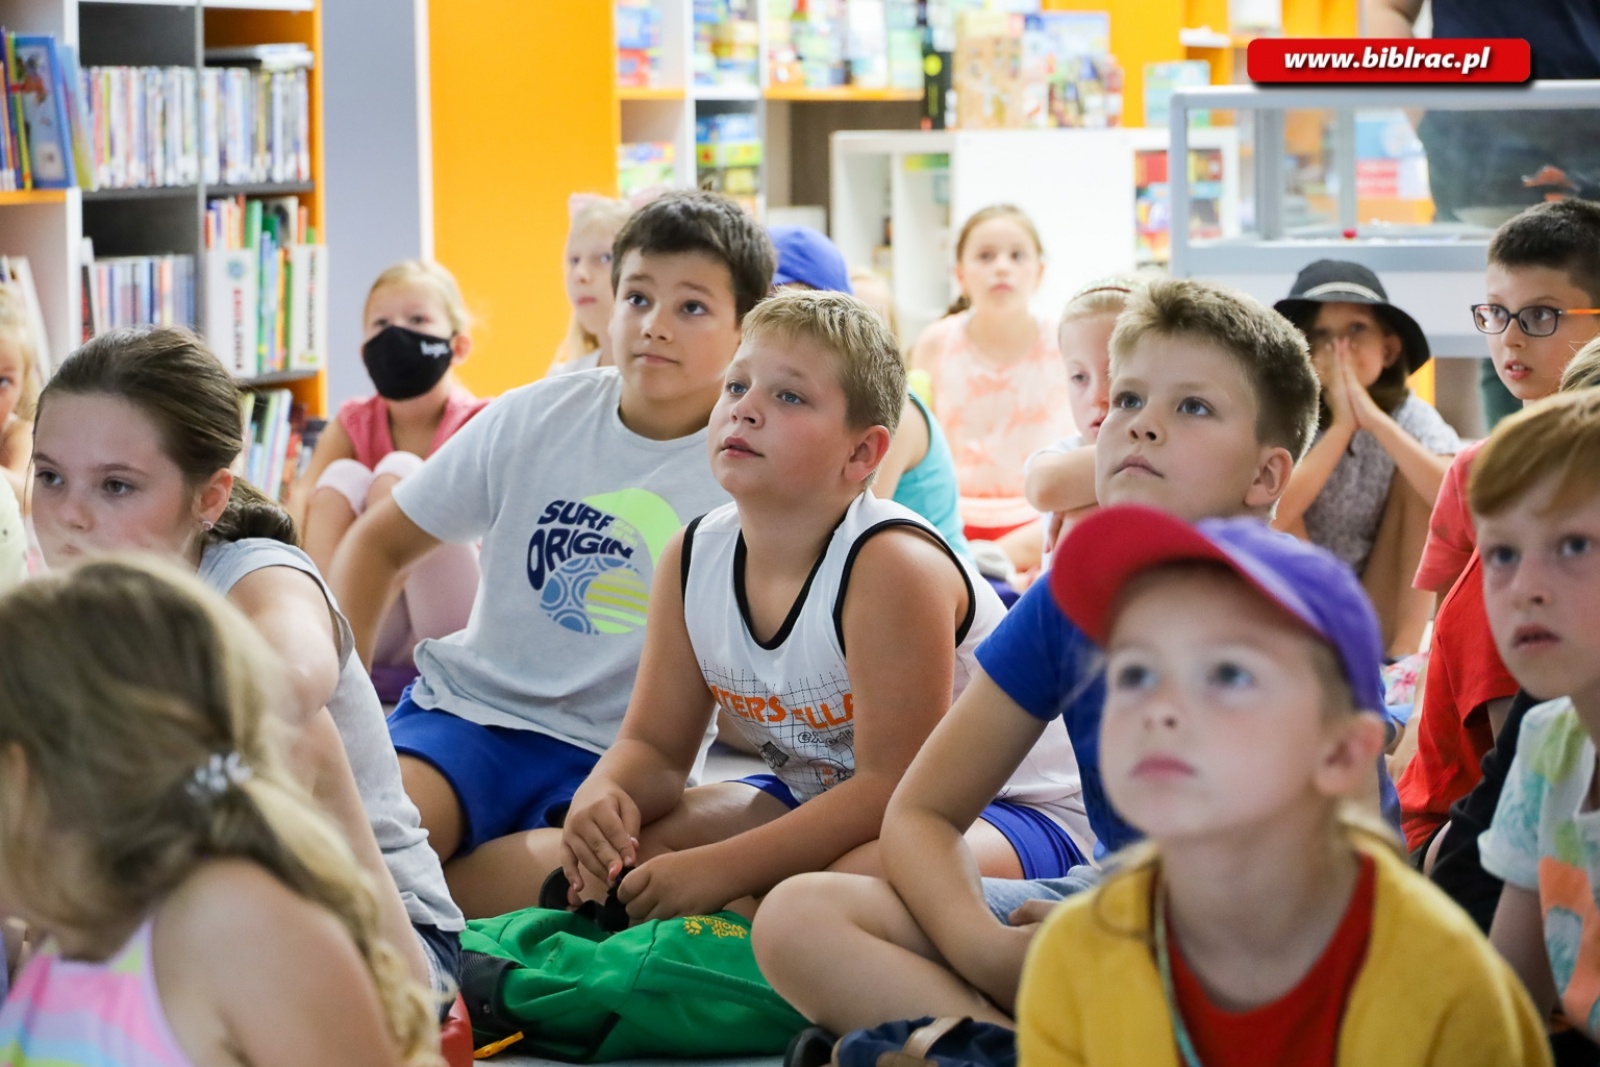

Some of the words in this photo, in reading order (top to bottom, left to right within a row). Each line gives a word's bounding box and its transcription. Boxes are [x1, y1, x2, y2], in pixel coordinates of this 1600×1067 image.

[537, 500, 615, 531] SURF
[527, 528, 634, 591] ORIGIN
[712, 926, 745, 938] Jack
